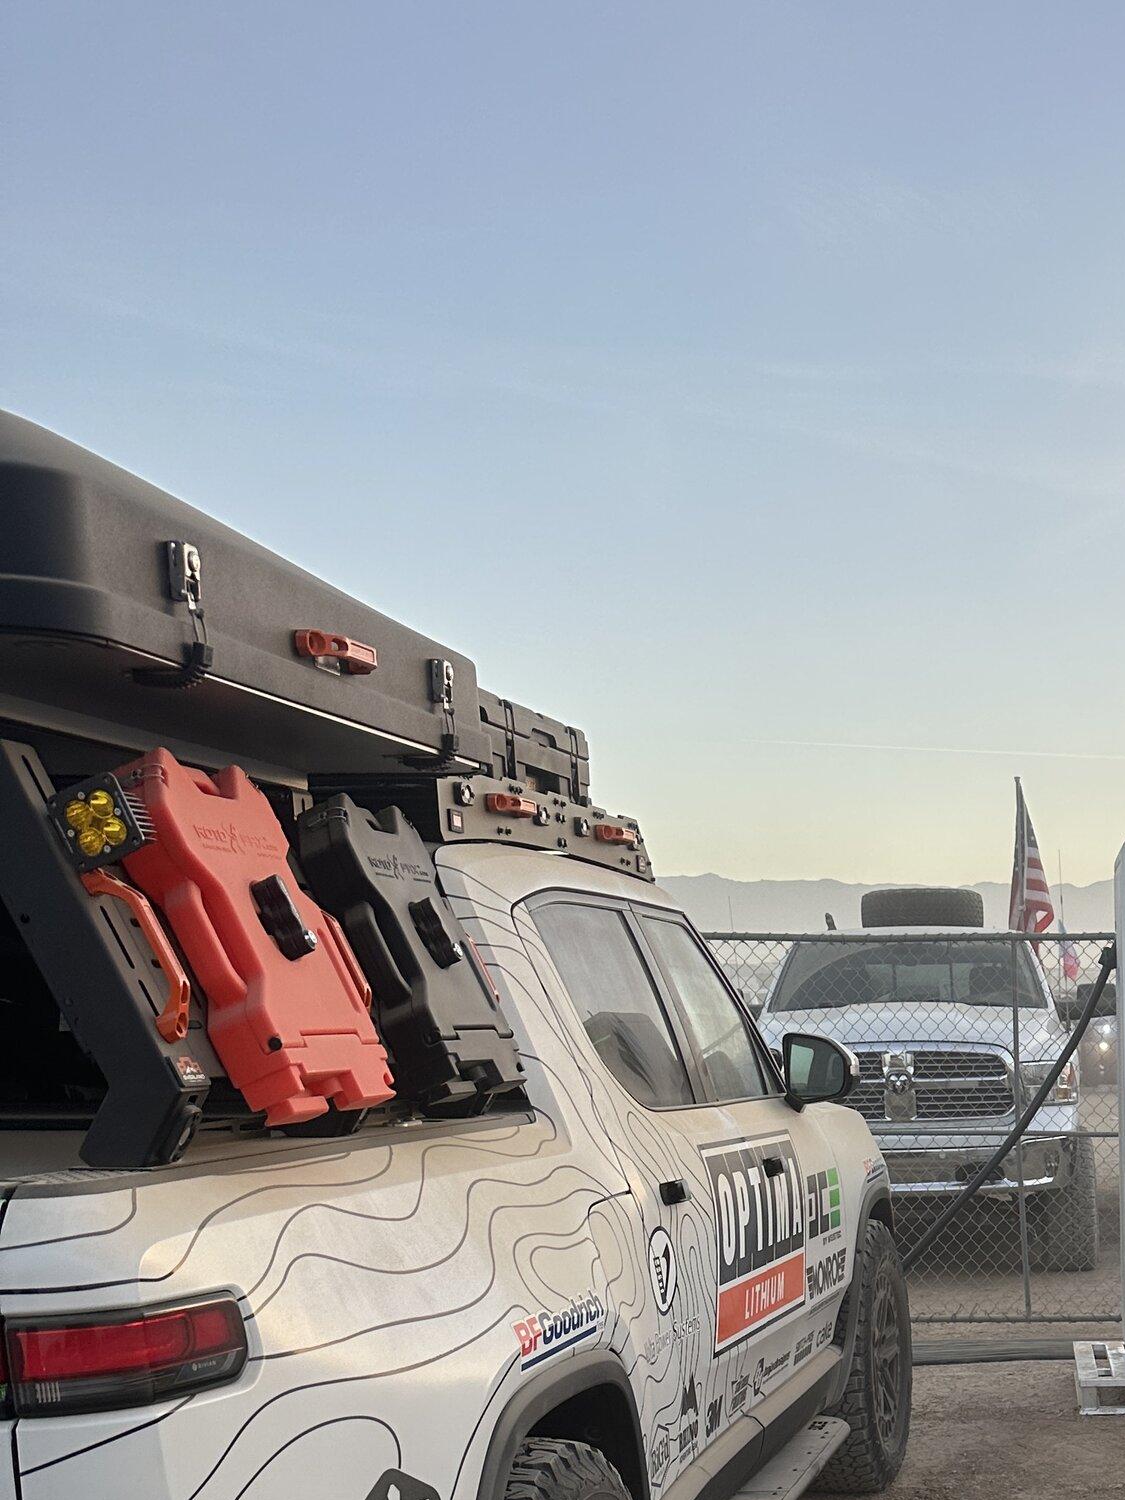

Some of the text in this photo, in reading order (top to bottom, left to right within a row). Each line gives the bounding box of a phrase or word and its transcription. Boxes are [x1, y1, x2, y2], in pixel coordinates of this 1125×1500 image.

[717, 1157, 803, 1266] OPTIMA
[744, 1271, 785, 1320] LITHIUM
[806, 1248, 847, 1300] MONROE
[513, 1289, 604, 1358] BFGoodrich
[673, 1317, 700, 1346] Systems
[706, 1394, 723, 1438] 3M
